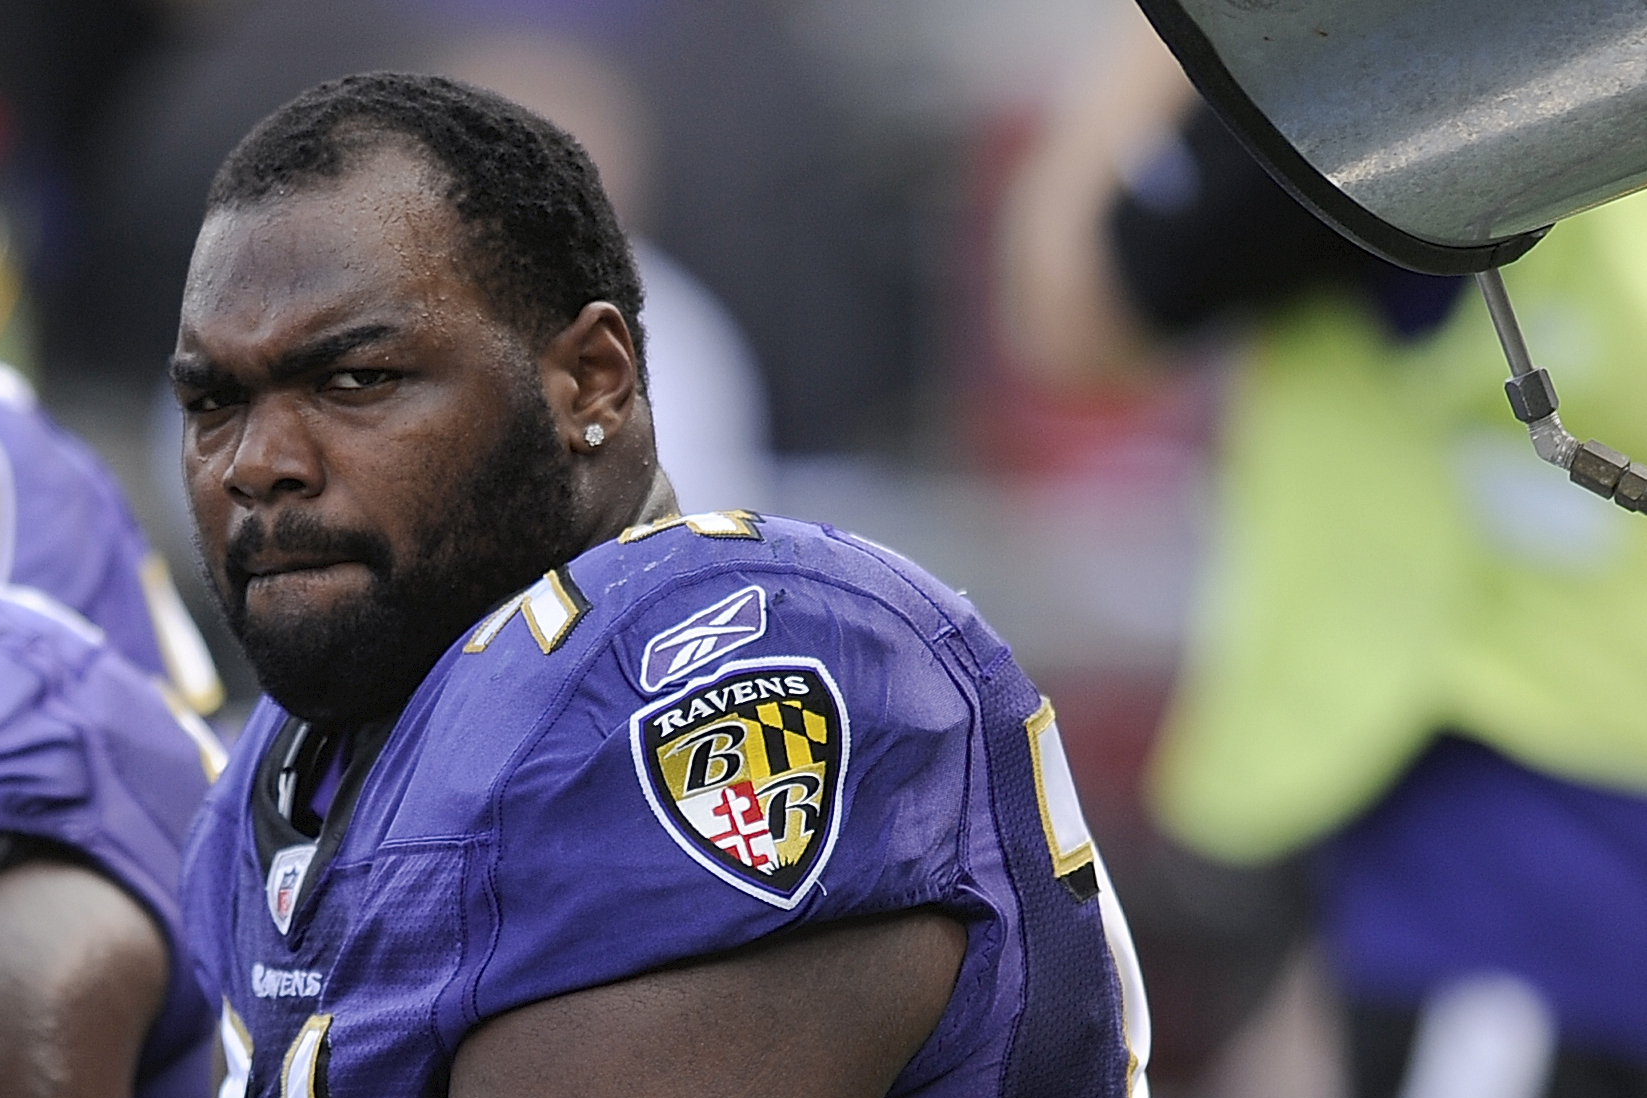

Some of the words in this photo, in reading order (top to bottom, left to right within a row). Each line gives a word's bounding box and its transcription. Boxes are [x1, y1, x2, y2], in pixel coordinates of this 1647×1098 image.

[653, 676, 810, 738] RAVENS
[663, 721, 748, 796] B
[755, 772, 820, 844] R
